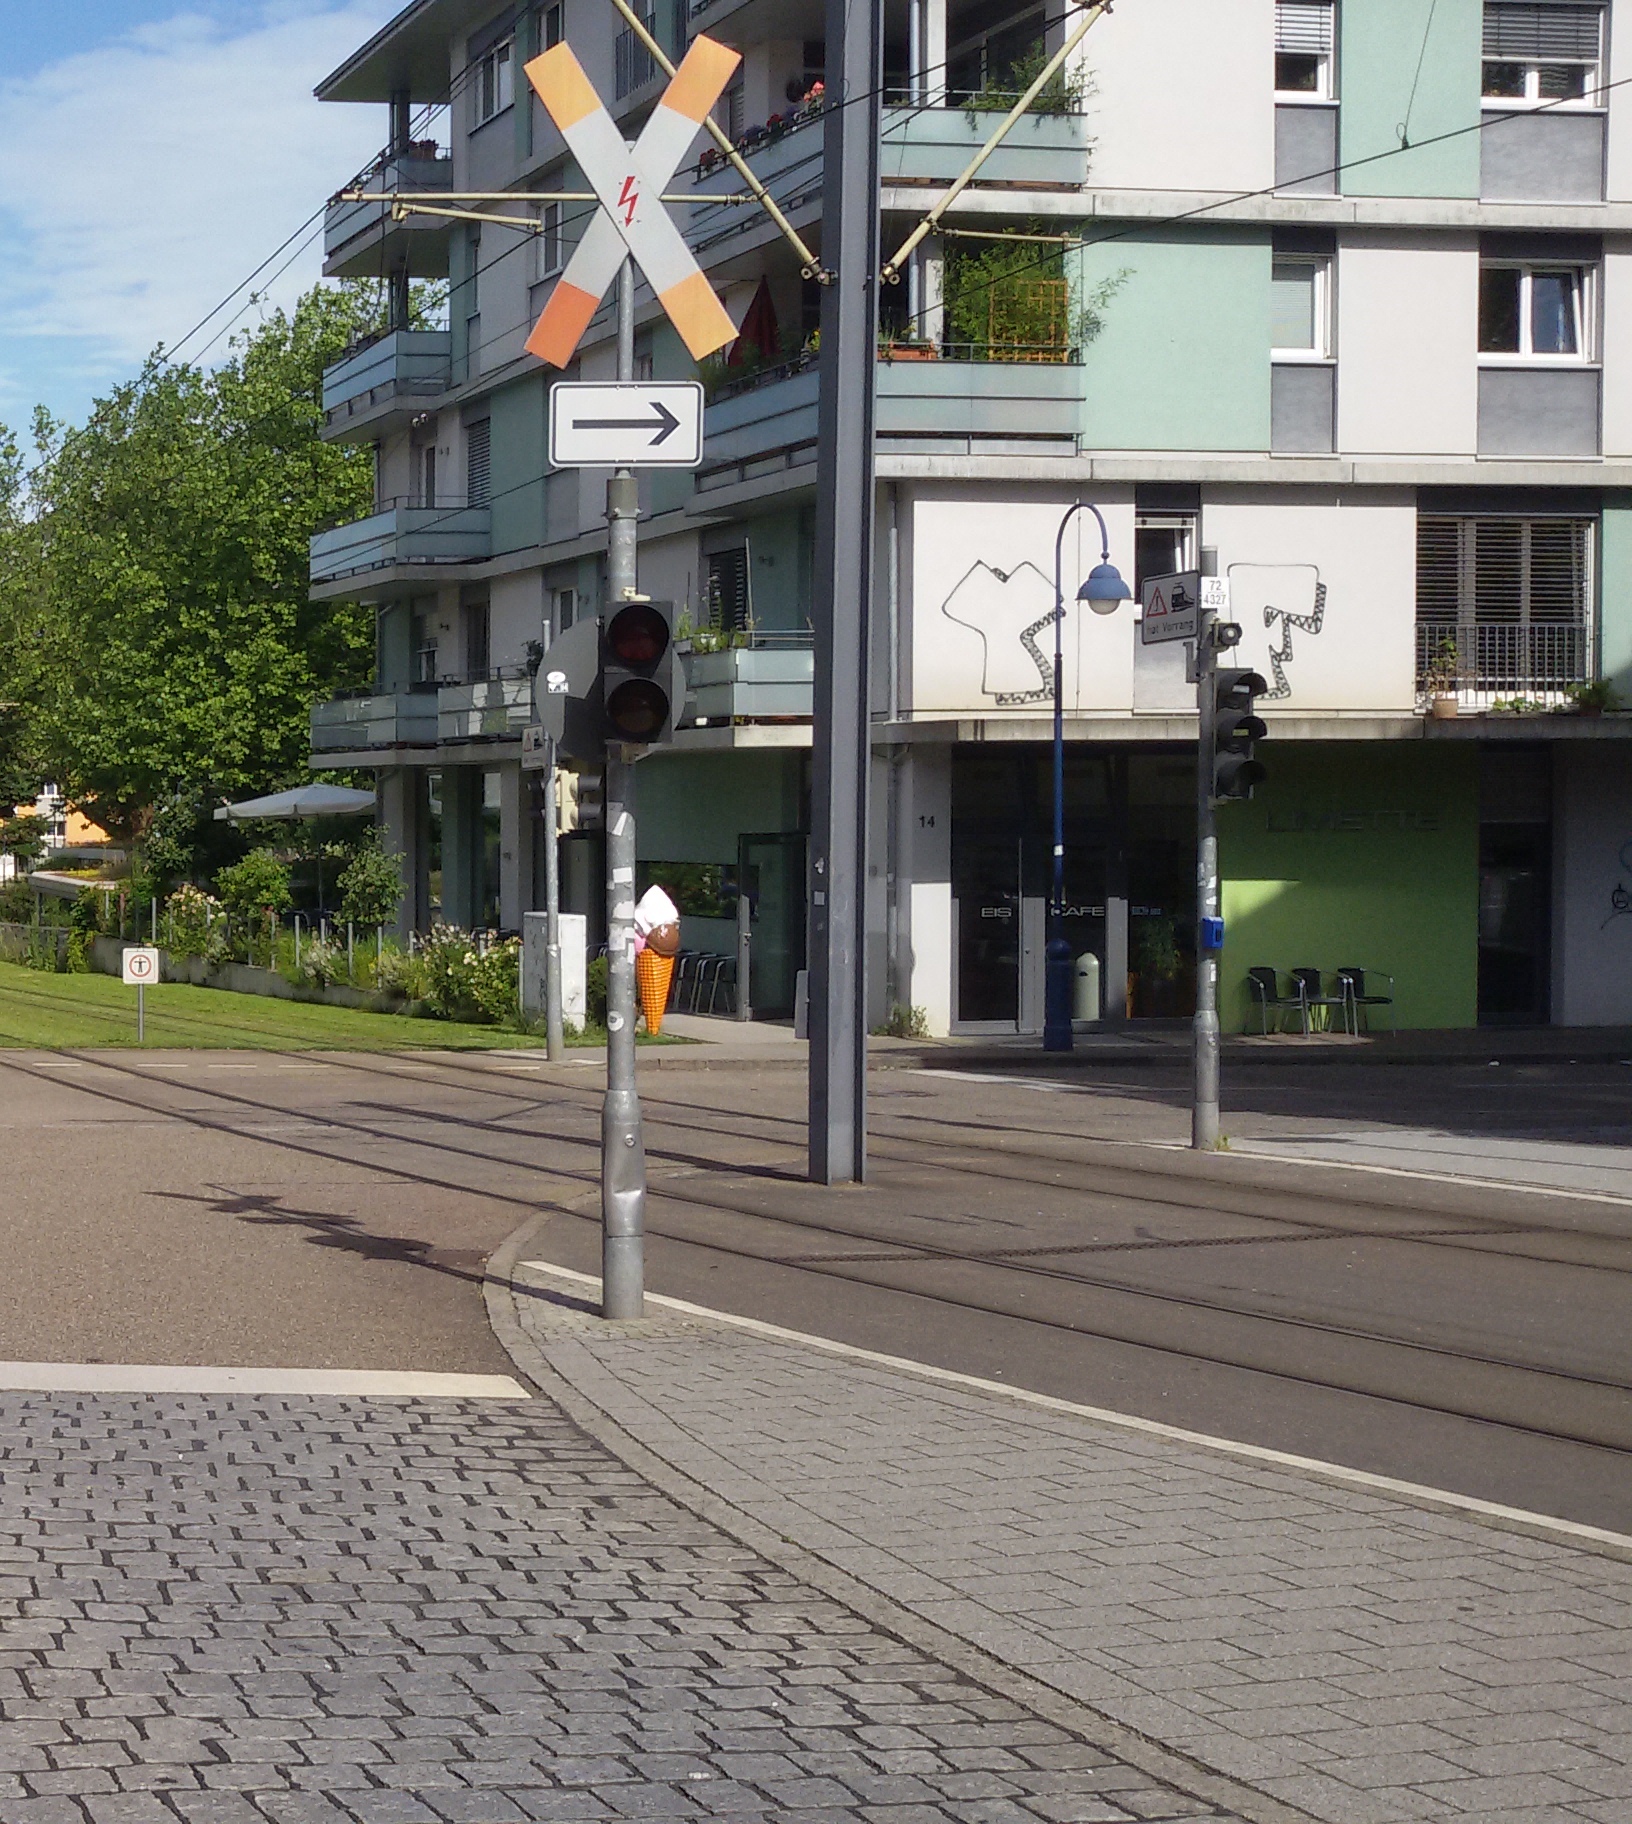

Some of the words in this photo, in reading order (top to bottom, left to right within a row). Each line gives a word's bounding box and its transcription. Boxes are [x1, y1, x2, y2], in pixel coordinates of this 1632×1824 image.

[1210, 580, 1222, 591] 72
[1204, 594, 1227, 605] 4327
[918, 815, 935, 828] 14
[981, 907, 1012, 918] EIS
